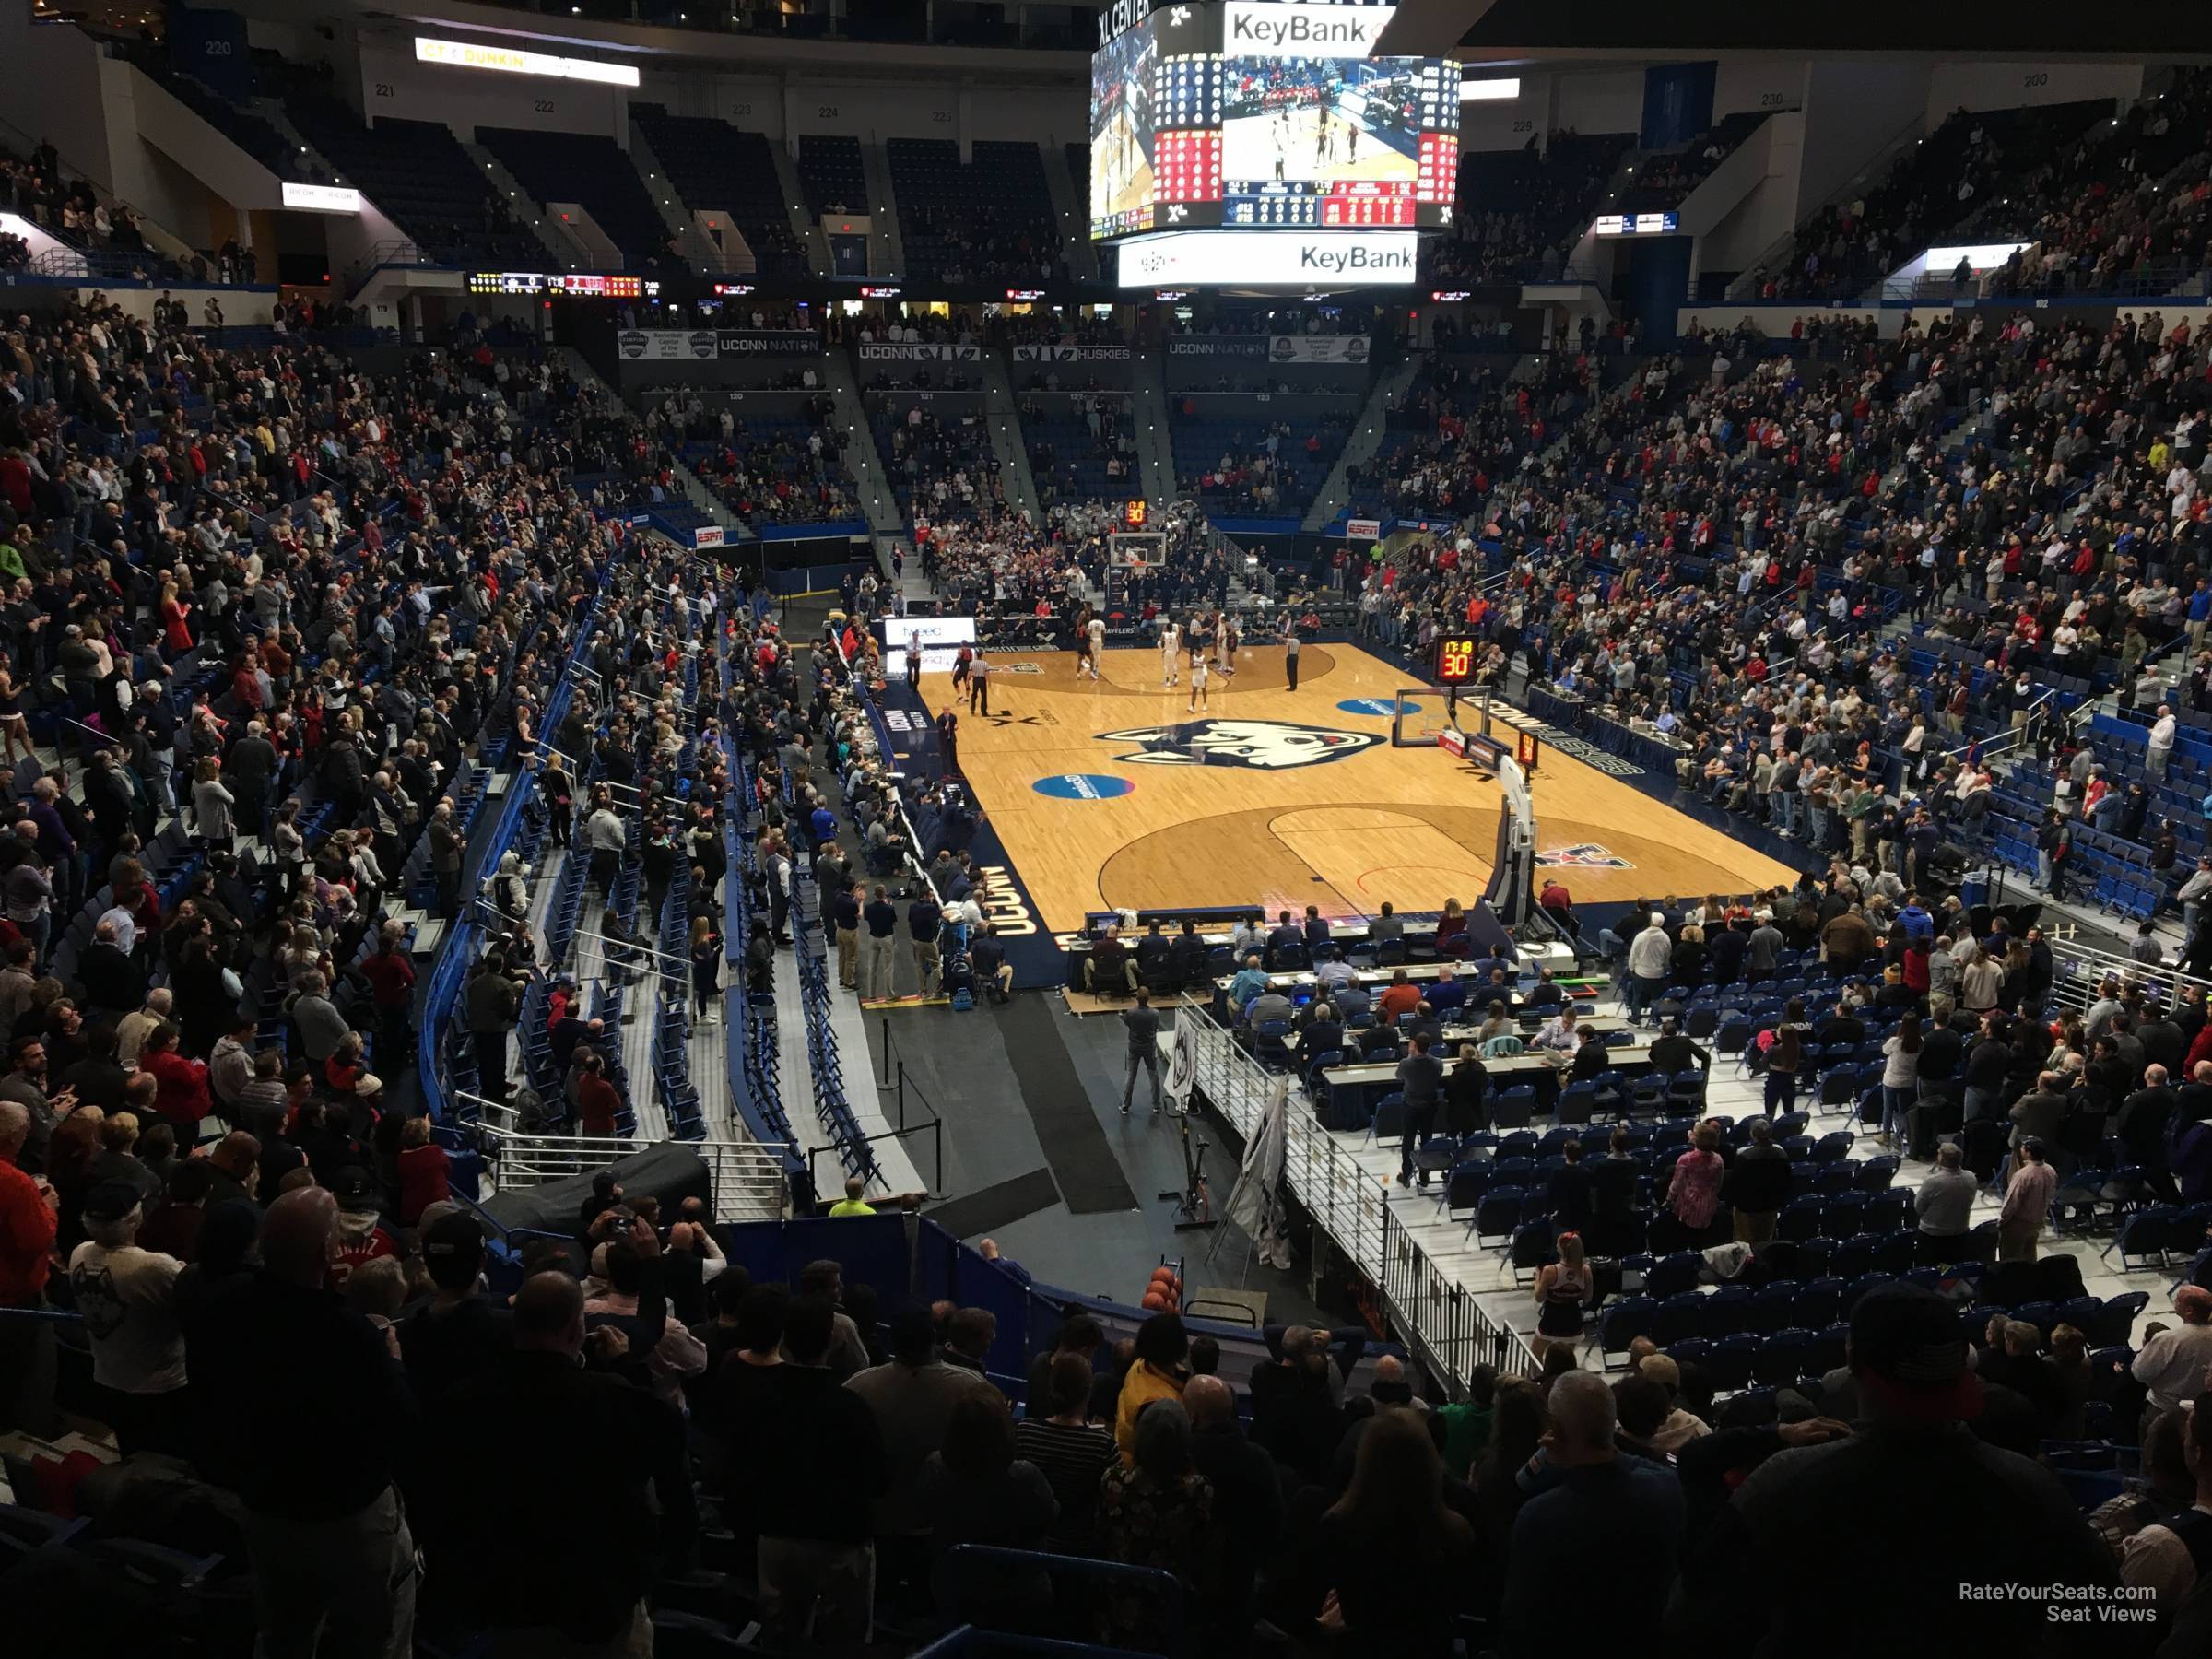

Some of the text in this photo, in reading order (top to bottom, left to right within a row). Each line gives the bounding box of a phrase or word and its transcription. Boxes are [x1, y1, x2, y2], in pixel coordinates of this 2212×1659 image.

[1099, 11, 1111, 48] XL
[1233, 13, 1366, 46] KeyBank
[206, 41, 231, 55] 220
[2023, 73, 2047, 88] 200
[376, 84, 394, 97] 221
[1761, 93, 1783, 105] 230
[535, 100, 554, 112] 222
[1295, 183, 1302, 194] 0
[1300, 244, 1414, 274] KeyBank
[2035, 299, 2049, 309] 102
[720, 339, 768, 351] UCONN
[1169, 343, 1215, 355] UCONN
[858, 346, 914, 359] UCONN
[1077, 348, 1130, 360] HUSKIES
[1127, 510, 1144, 523] 30
[1347, 524, 1380, 535] ESPN
[697, 531, 723, 543] ESPN
[1104, 627, 1135, 635] RAVELERS
[1444, 654, 1468, 677] 30
[883, 709, 912, 732] UCONN
[980, 865, 1037, 936] UCONN
